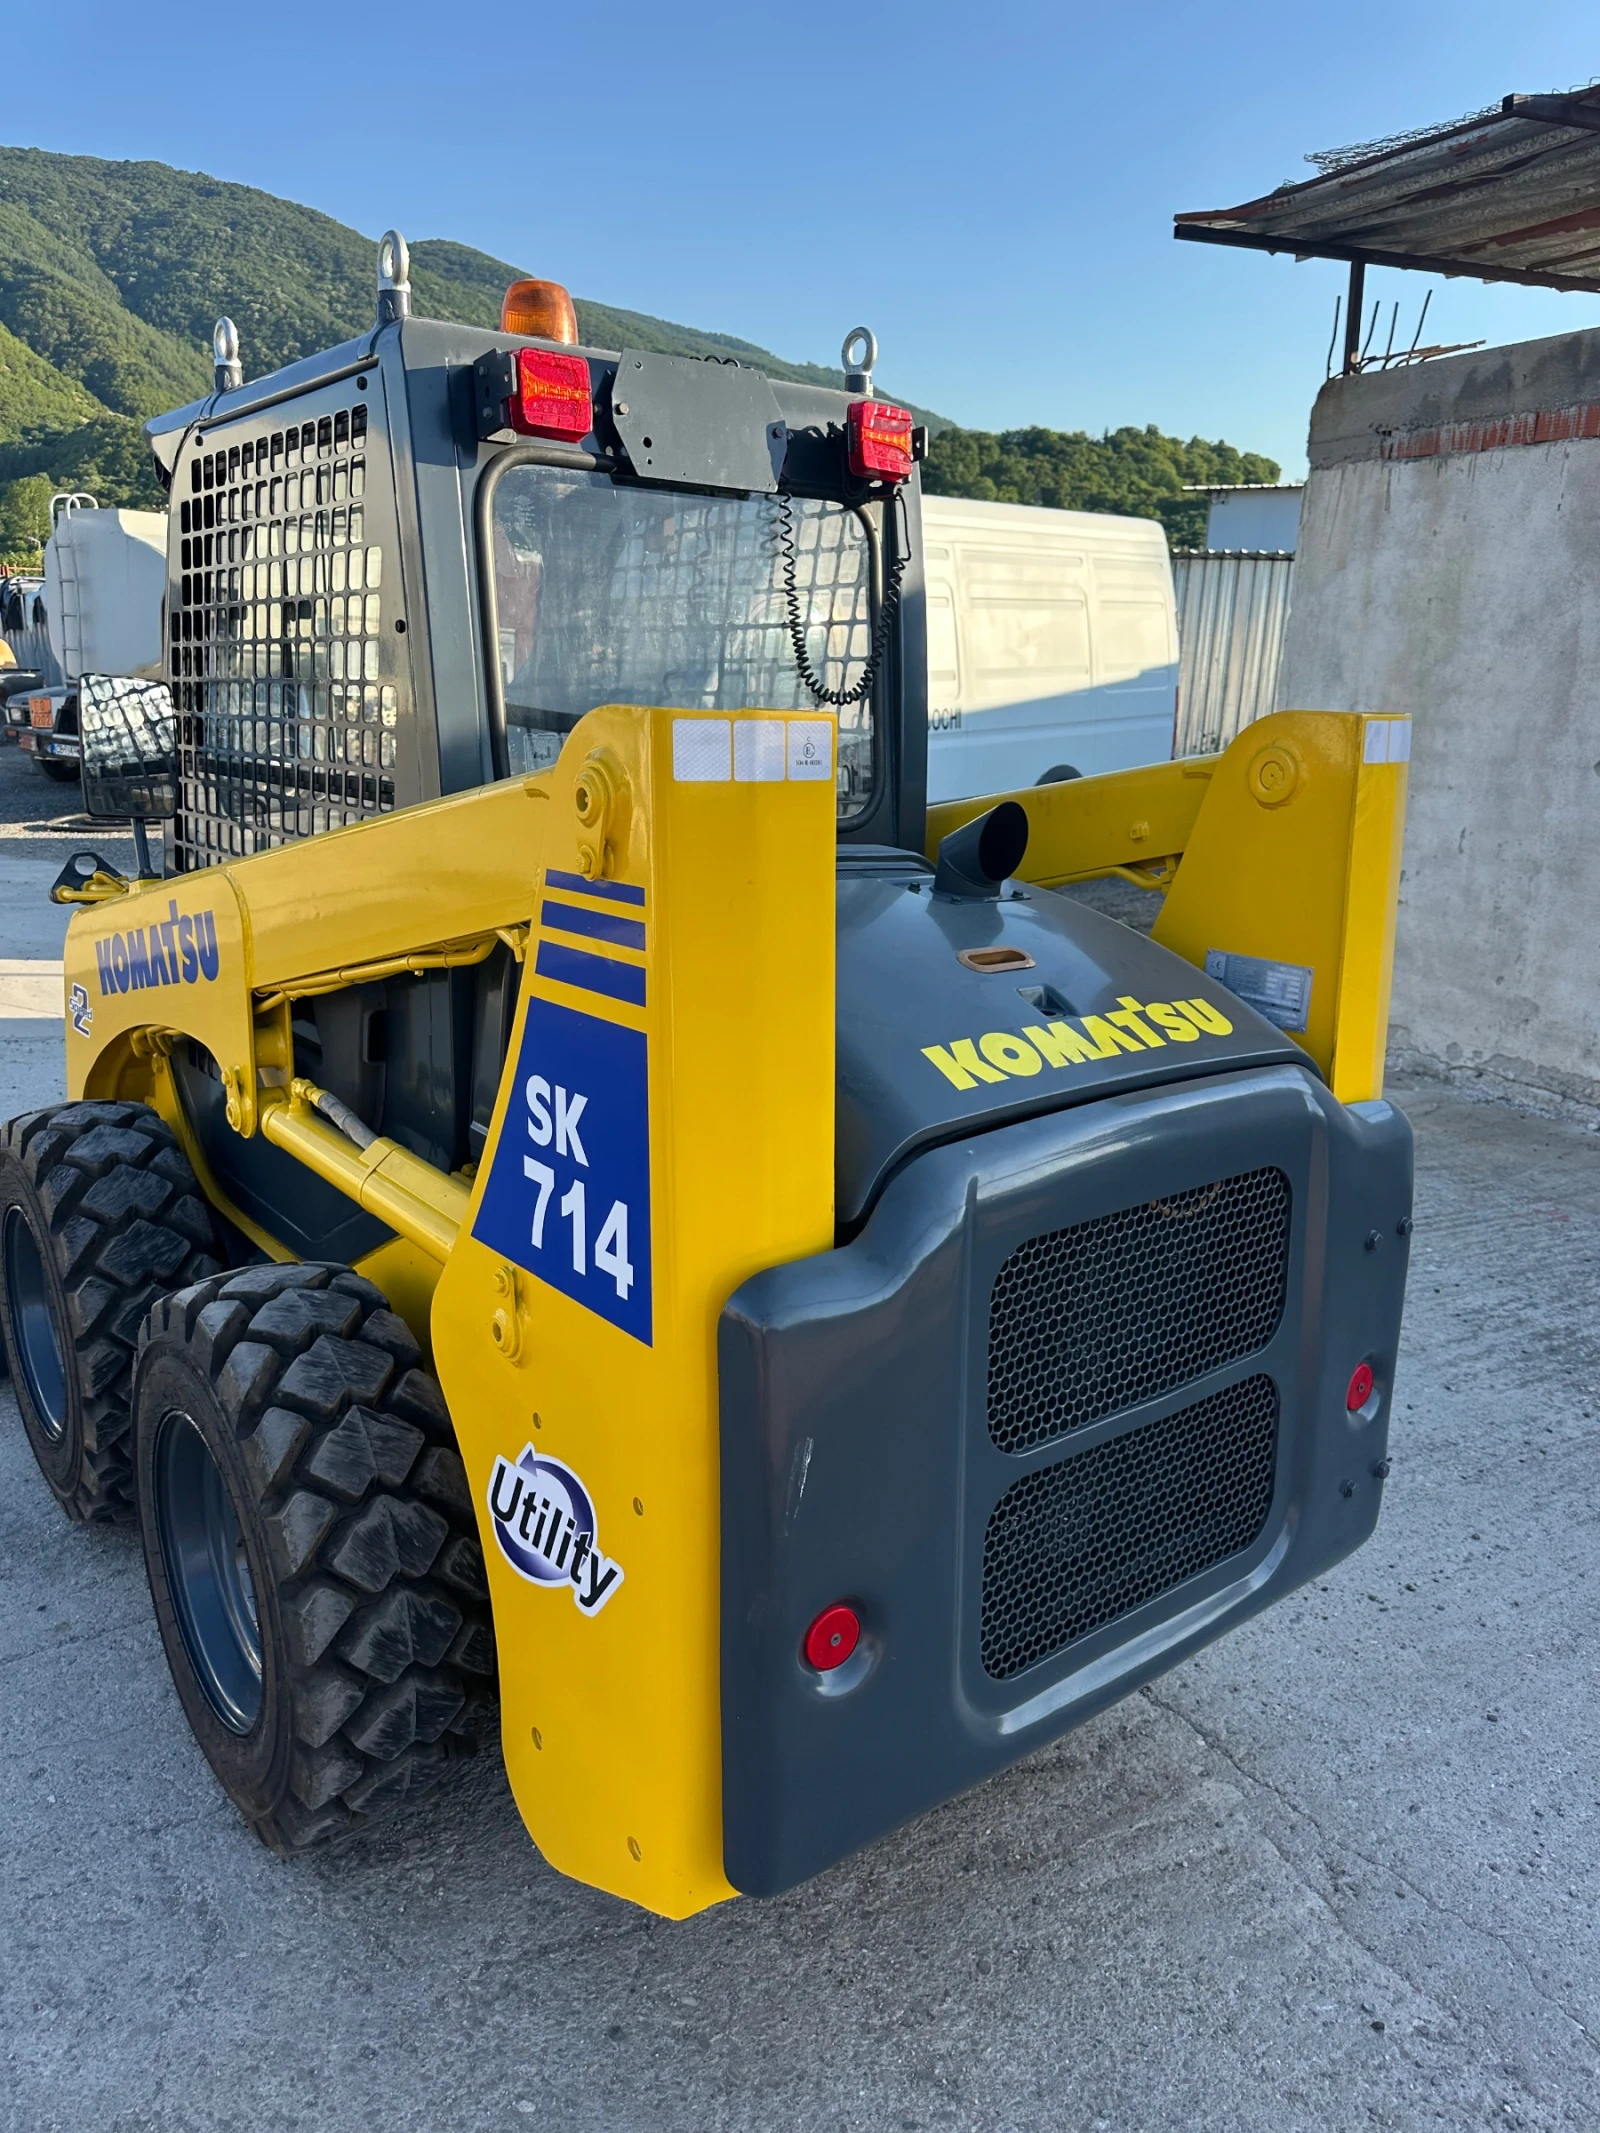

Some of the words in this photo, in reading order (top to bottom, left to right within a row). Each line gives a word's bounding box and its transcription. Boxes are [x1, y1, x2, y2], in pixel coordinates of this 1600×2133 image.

[928, 708, 961, 730] OCHI
[95, 899, 219, 996] KOMATSU
[921, 996, 1233, 1091] KOMATSU
[526, 1074, 589, 1167] SK
[523, 1154, 634, 1301] 714
[491, 1463, 618, 1608] Utility
